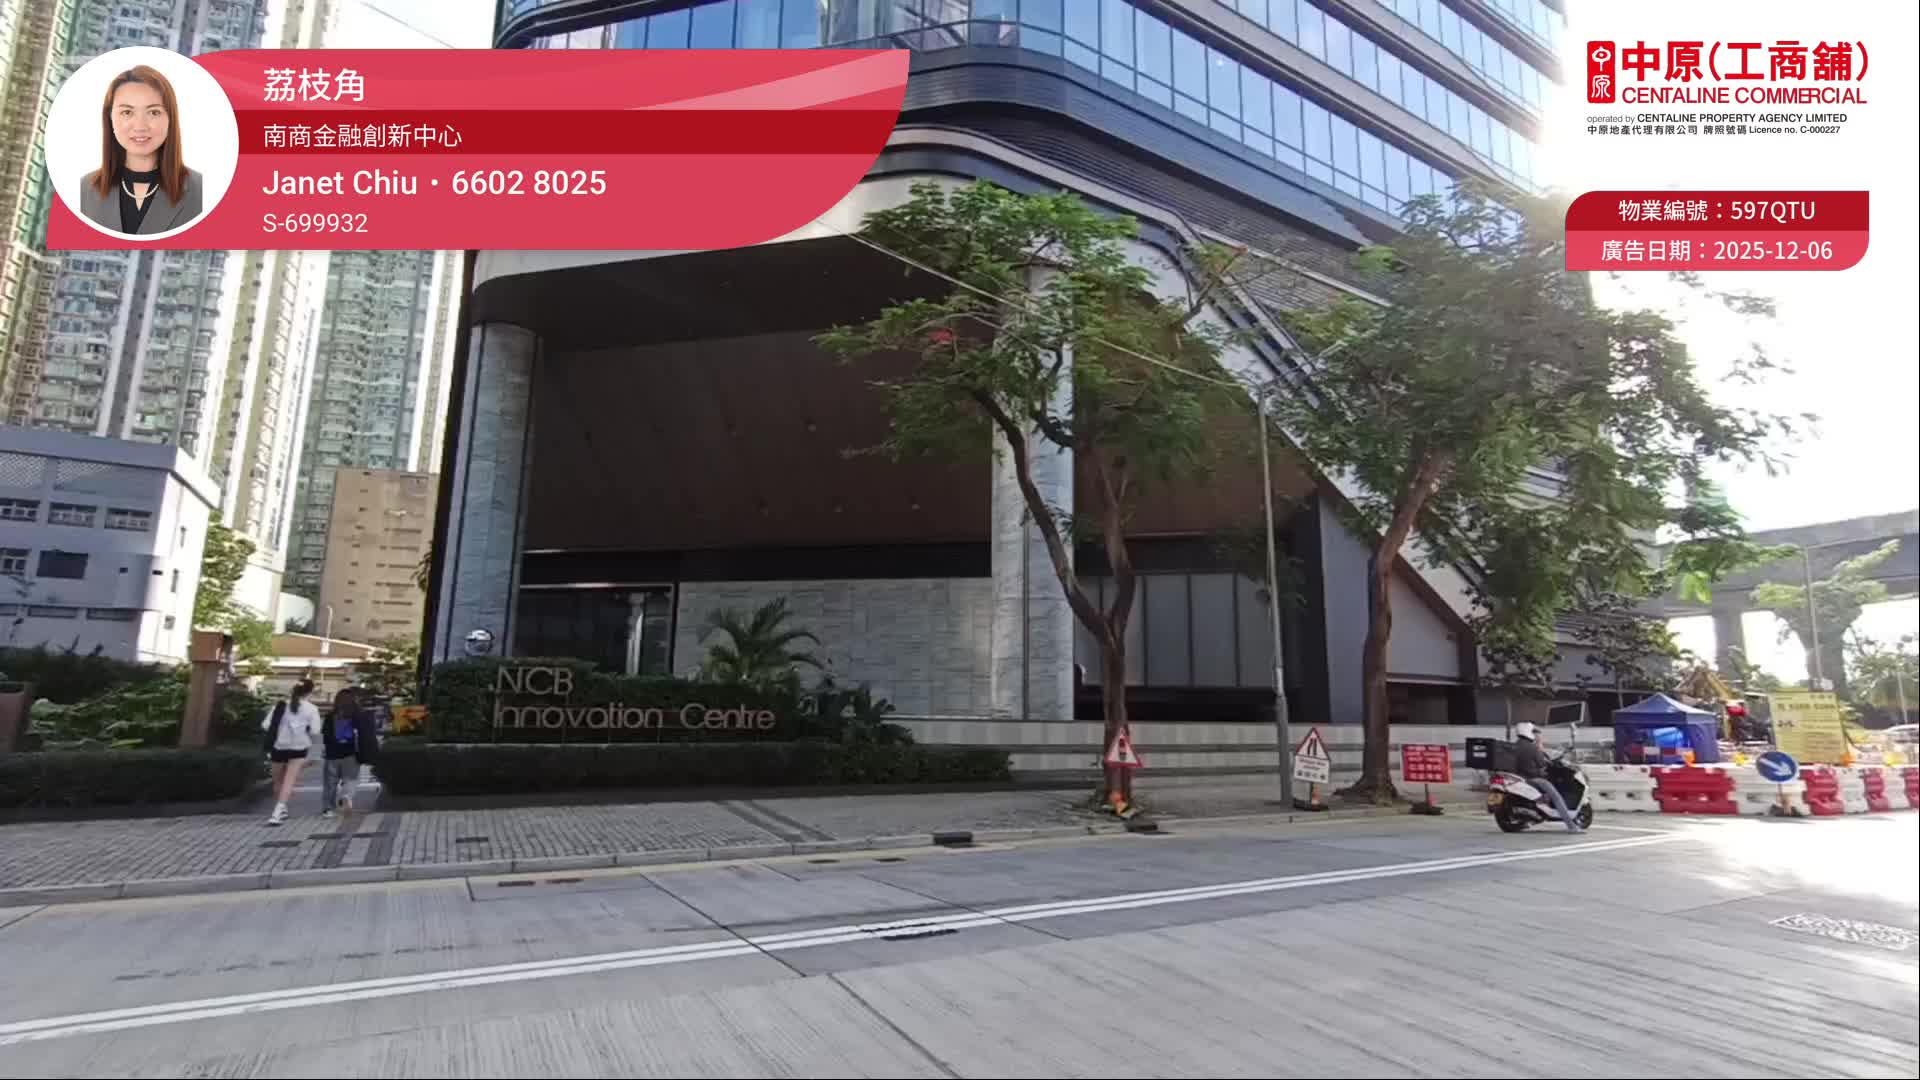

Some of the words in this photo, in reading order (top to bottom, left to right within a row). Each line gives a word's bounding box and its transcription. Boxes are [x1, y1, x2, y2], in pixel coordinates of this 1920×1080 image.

[496, 666, 574, 695] NCB
[493, 697, 664, 729] Innovation
[680, 703, 777, 729] Centre
